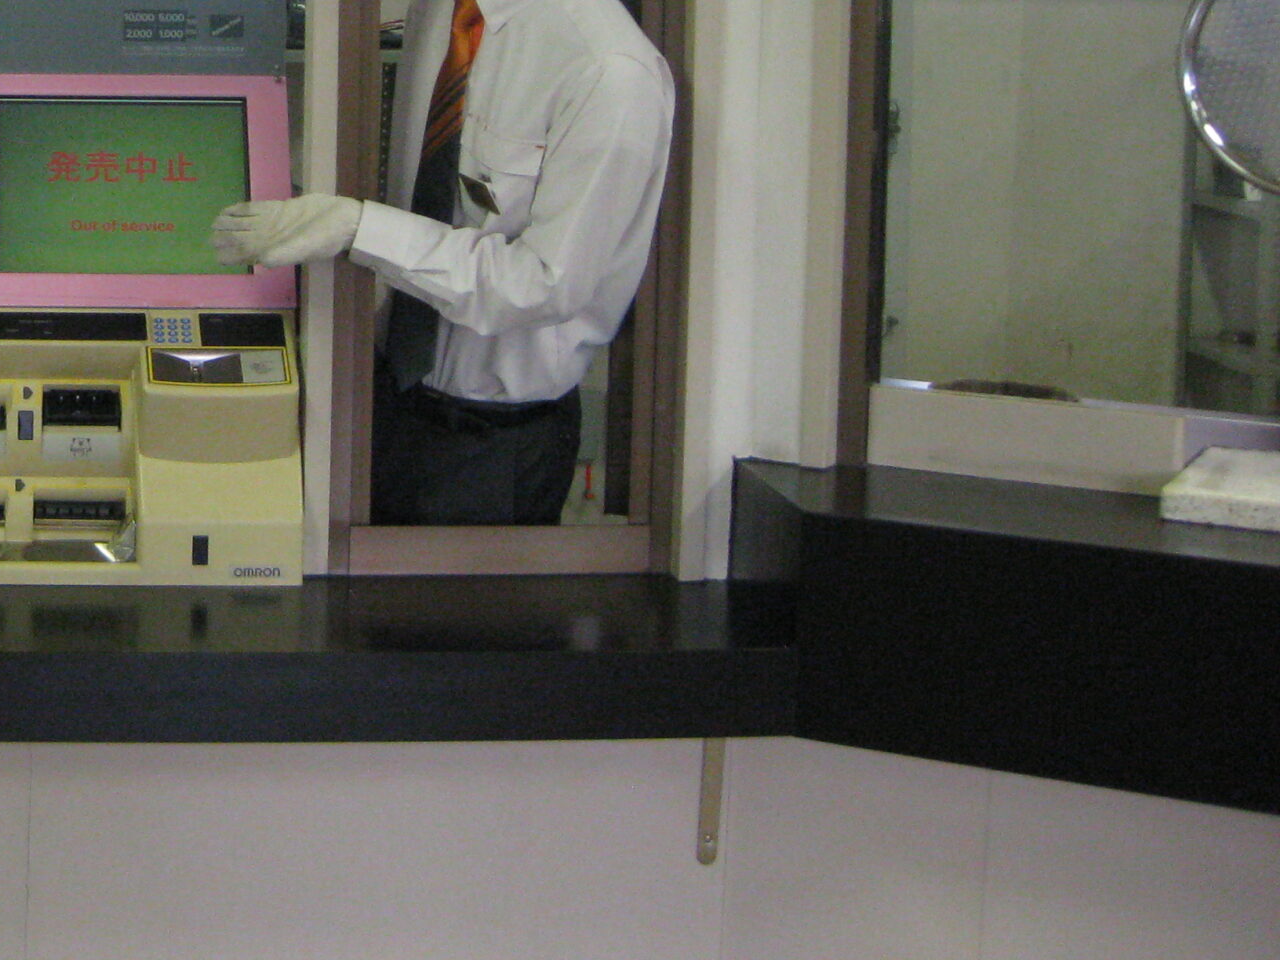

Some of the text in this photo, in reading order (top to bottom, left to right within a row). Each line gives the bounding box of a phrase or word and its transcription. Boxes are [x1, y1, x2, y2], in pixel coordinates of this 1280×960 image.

[124, 12, 155, 22] 10,000
[125, 29, 183, 38] 2,000 1,000
[47, 151, 199, 183] 発売中止
[71, 220, 175, 232] Out of service
[233, 567, 281, 577] OMRON
